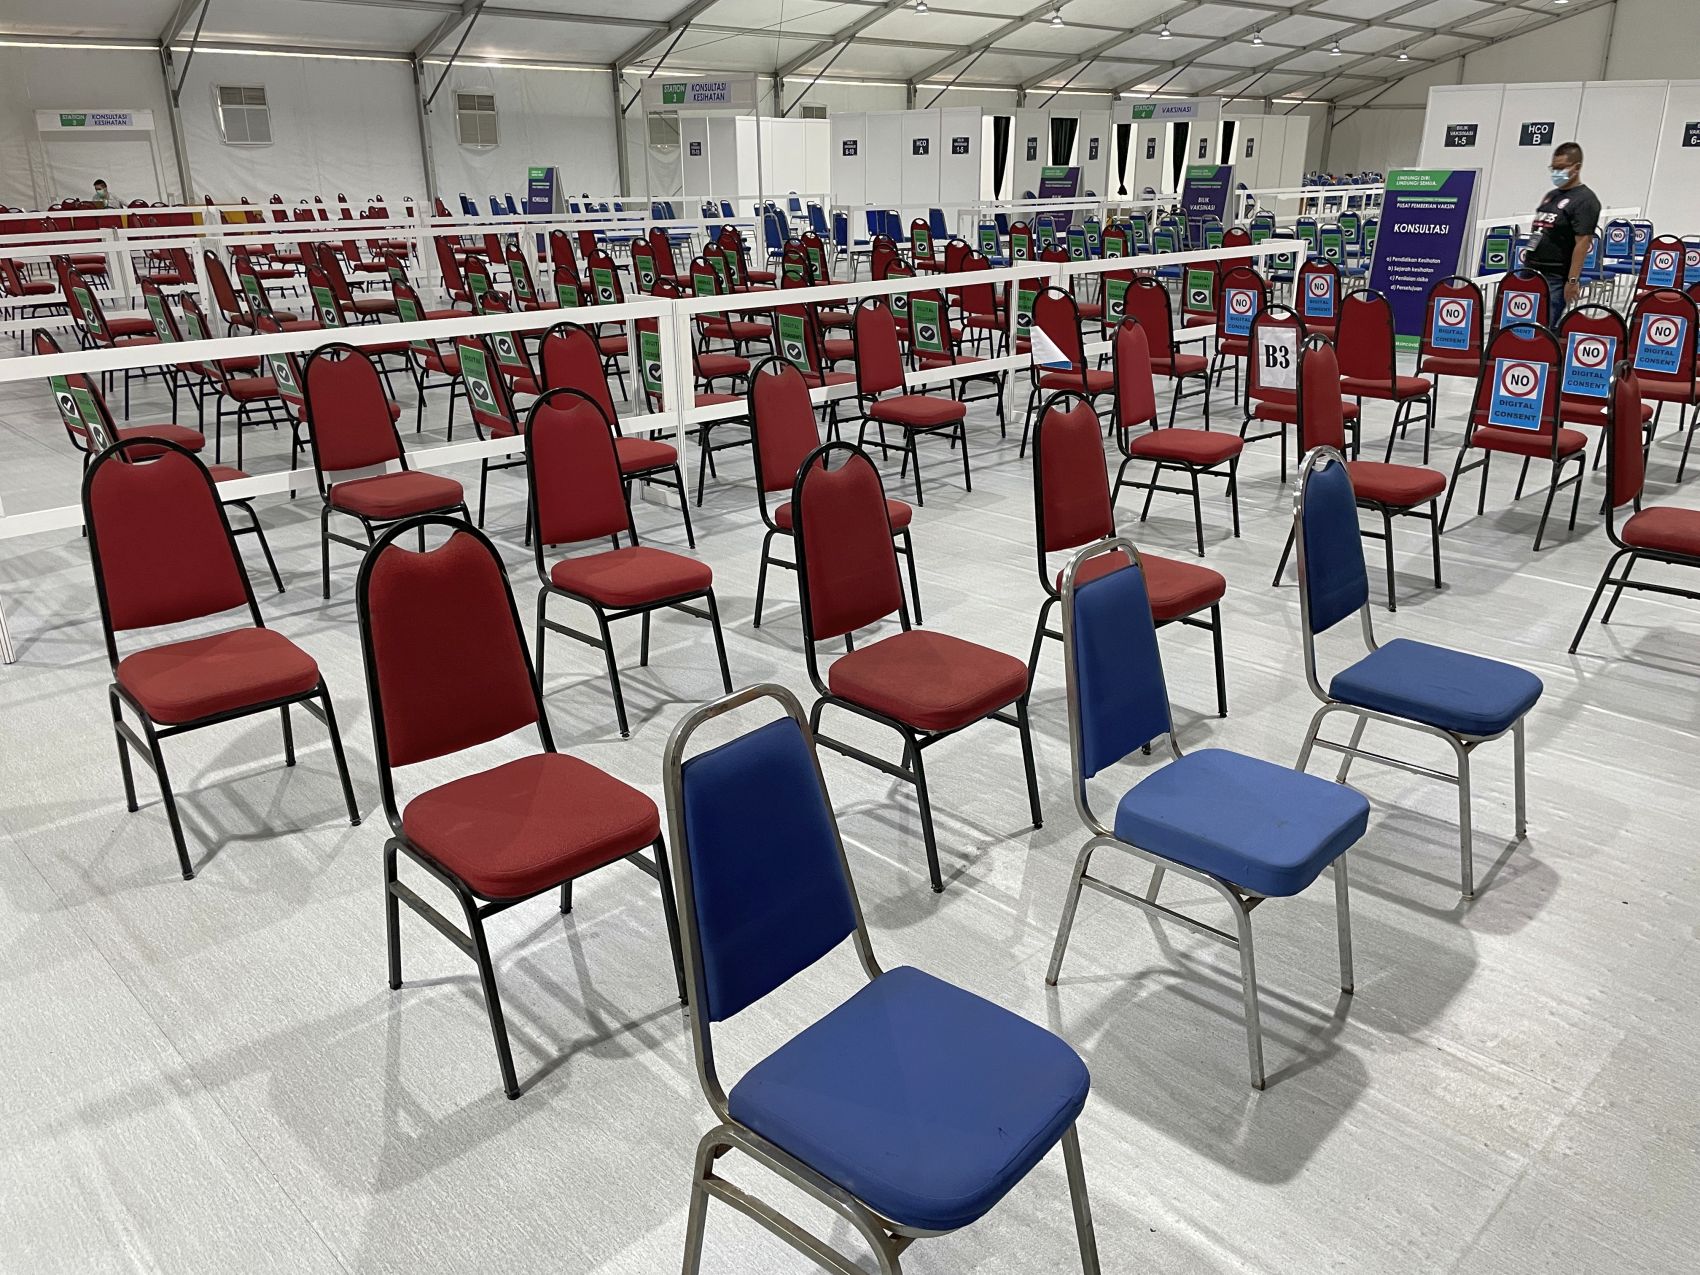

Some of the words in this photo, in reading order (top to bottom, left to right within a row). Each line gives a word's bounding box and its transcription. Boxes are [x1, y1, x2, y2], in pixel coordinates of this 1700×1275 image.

[664, 85, 684, 93] STATION
[692, 83, 726, 92] KONSULTASI
[694, 93, 725, 101] KESIHATAN
[1528, 125, 1549, 134] HCO
[1454, 137, 1467, 145] 1-5
[1532, 134, 1541, 144] B
[1691, 136, 1700, 144] 6-
[1394, 224, 1449, 234] KONSULTASI
[1314, 282, 1325, 291] NO
[1235, 298, 1247, 308] NO
[1514, 302, 1527, 310] NO
[1446, 309, 1460, 318] NO
[1654, 326, 1671, 337] NO
[1582, 346, 1600, 358] NO
[1644, 348, 1674, 356] DIGITAL
[1264, 345, 1290, 369] B3
[1640, 357, 1676, 366] CONSENT
[1572, 370, 1604, 379] DIGITAL
[1511, 374, 1529, 386] NO
[1567, 380, 1606, 390] CONSENT
[1499, 399, 1535, 410] DIGITAL
[1495, 410, 1536, 421] CONSENT
